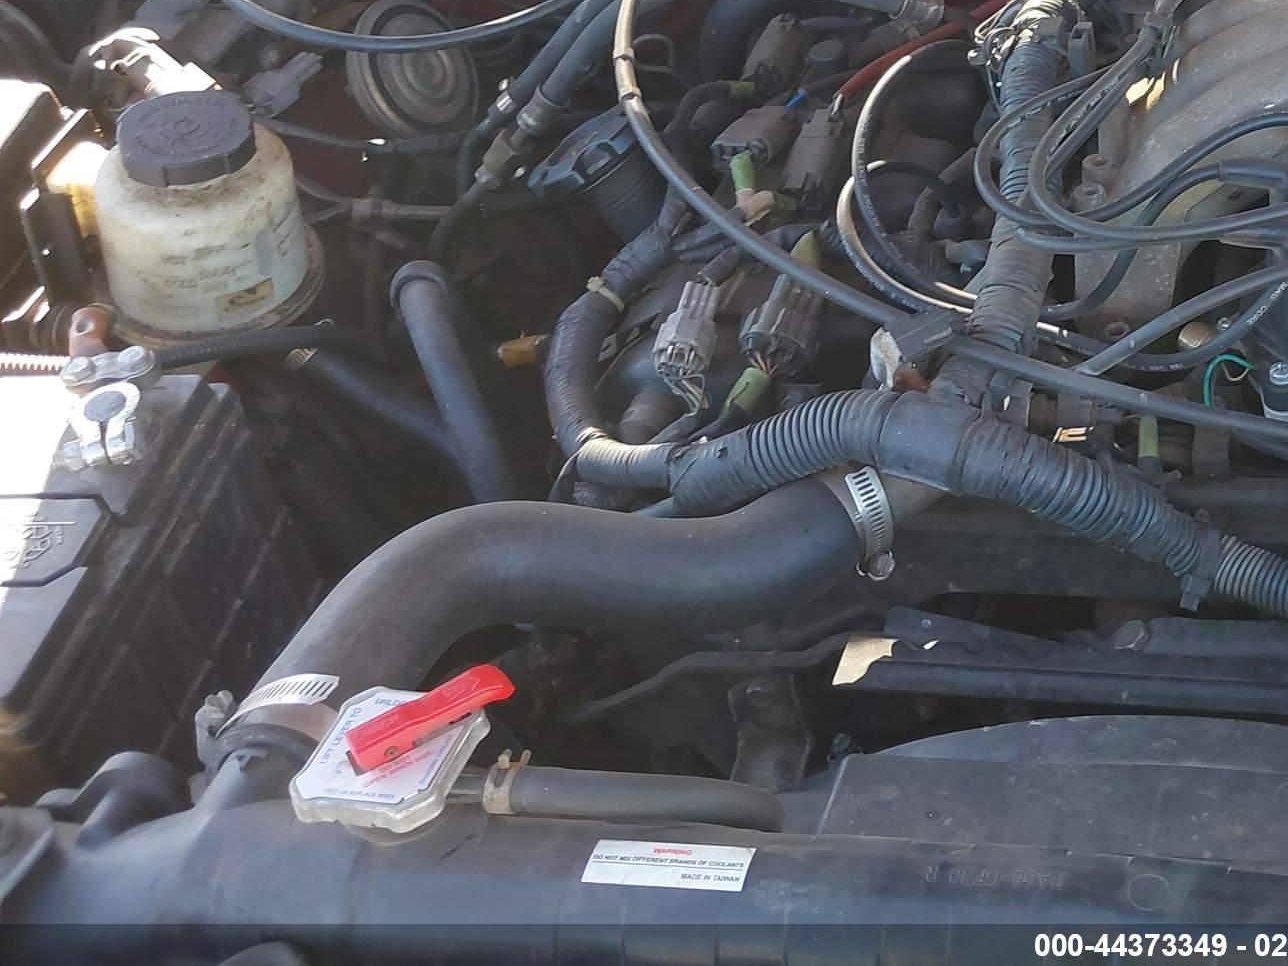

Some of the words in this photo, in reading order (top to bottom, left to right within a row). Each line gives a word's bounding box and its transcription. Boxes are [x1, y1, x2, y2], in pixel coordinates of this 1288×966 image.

[632, 856, 669, 865] DIFFERENT
[680, 872, 703, 881] MADE
[713, 874, 741, 883] TAIWAN
